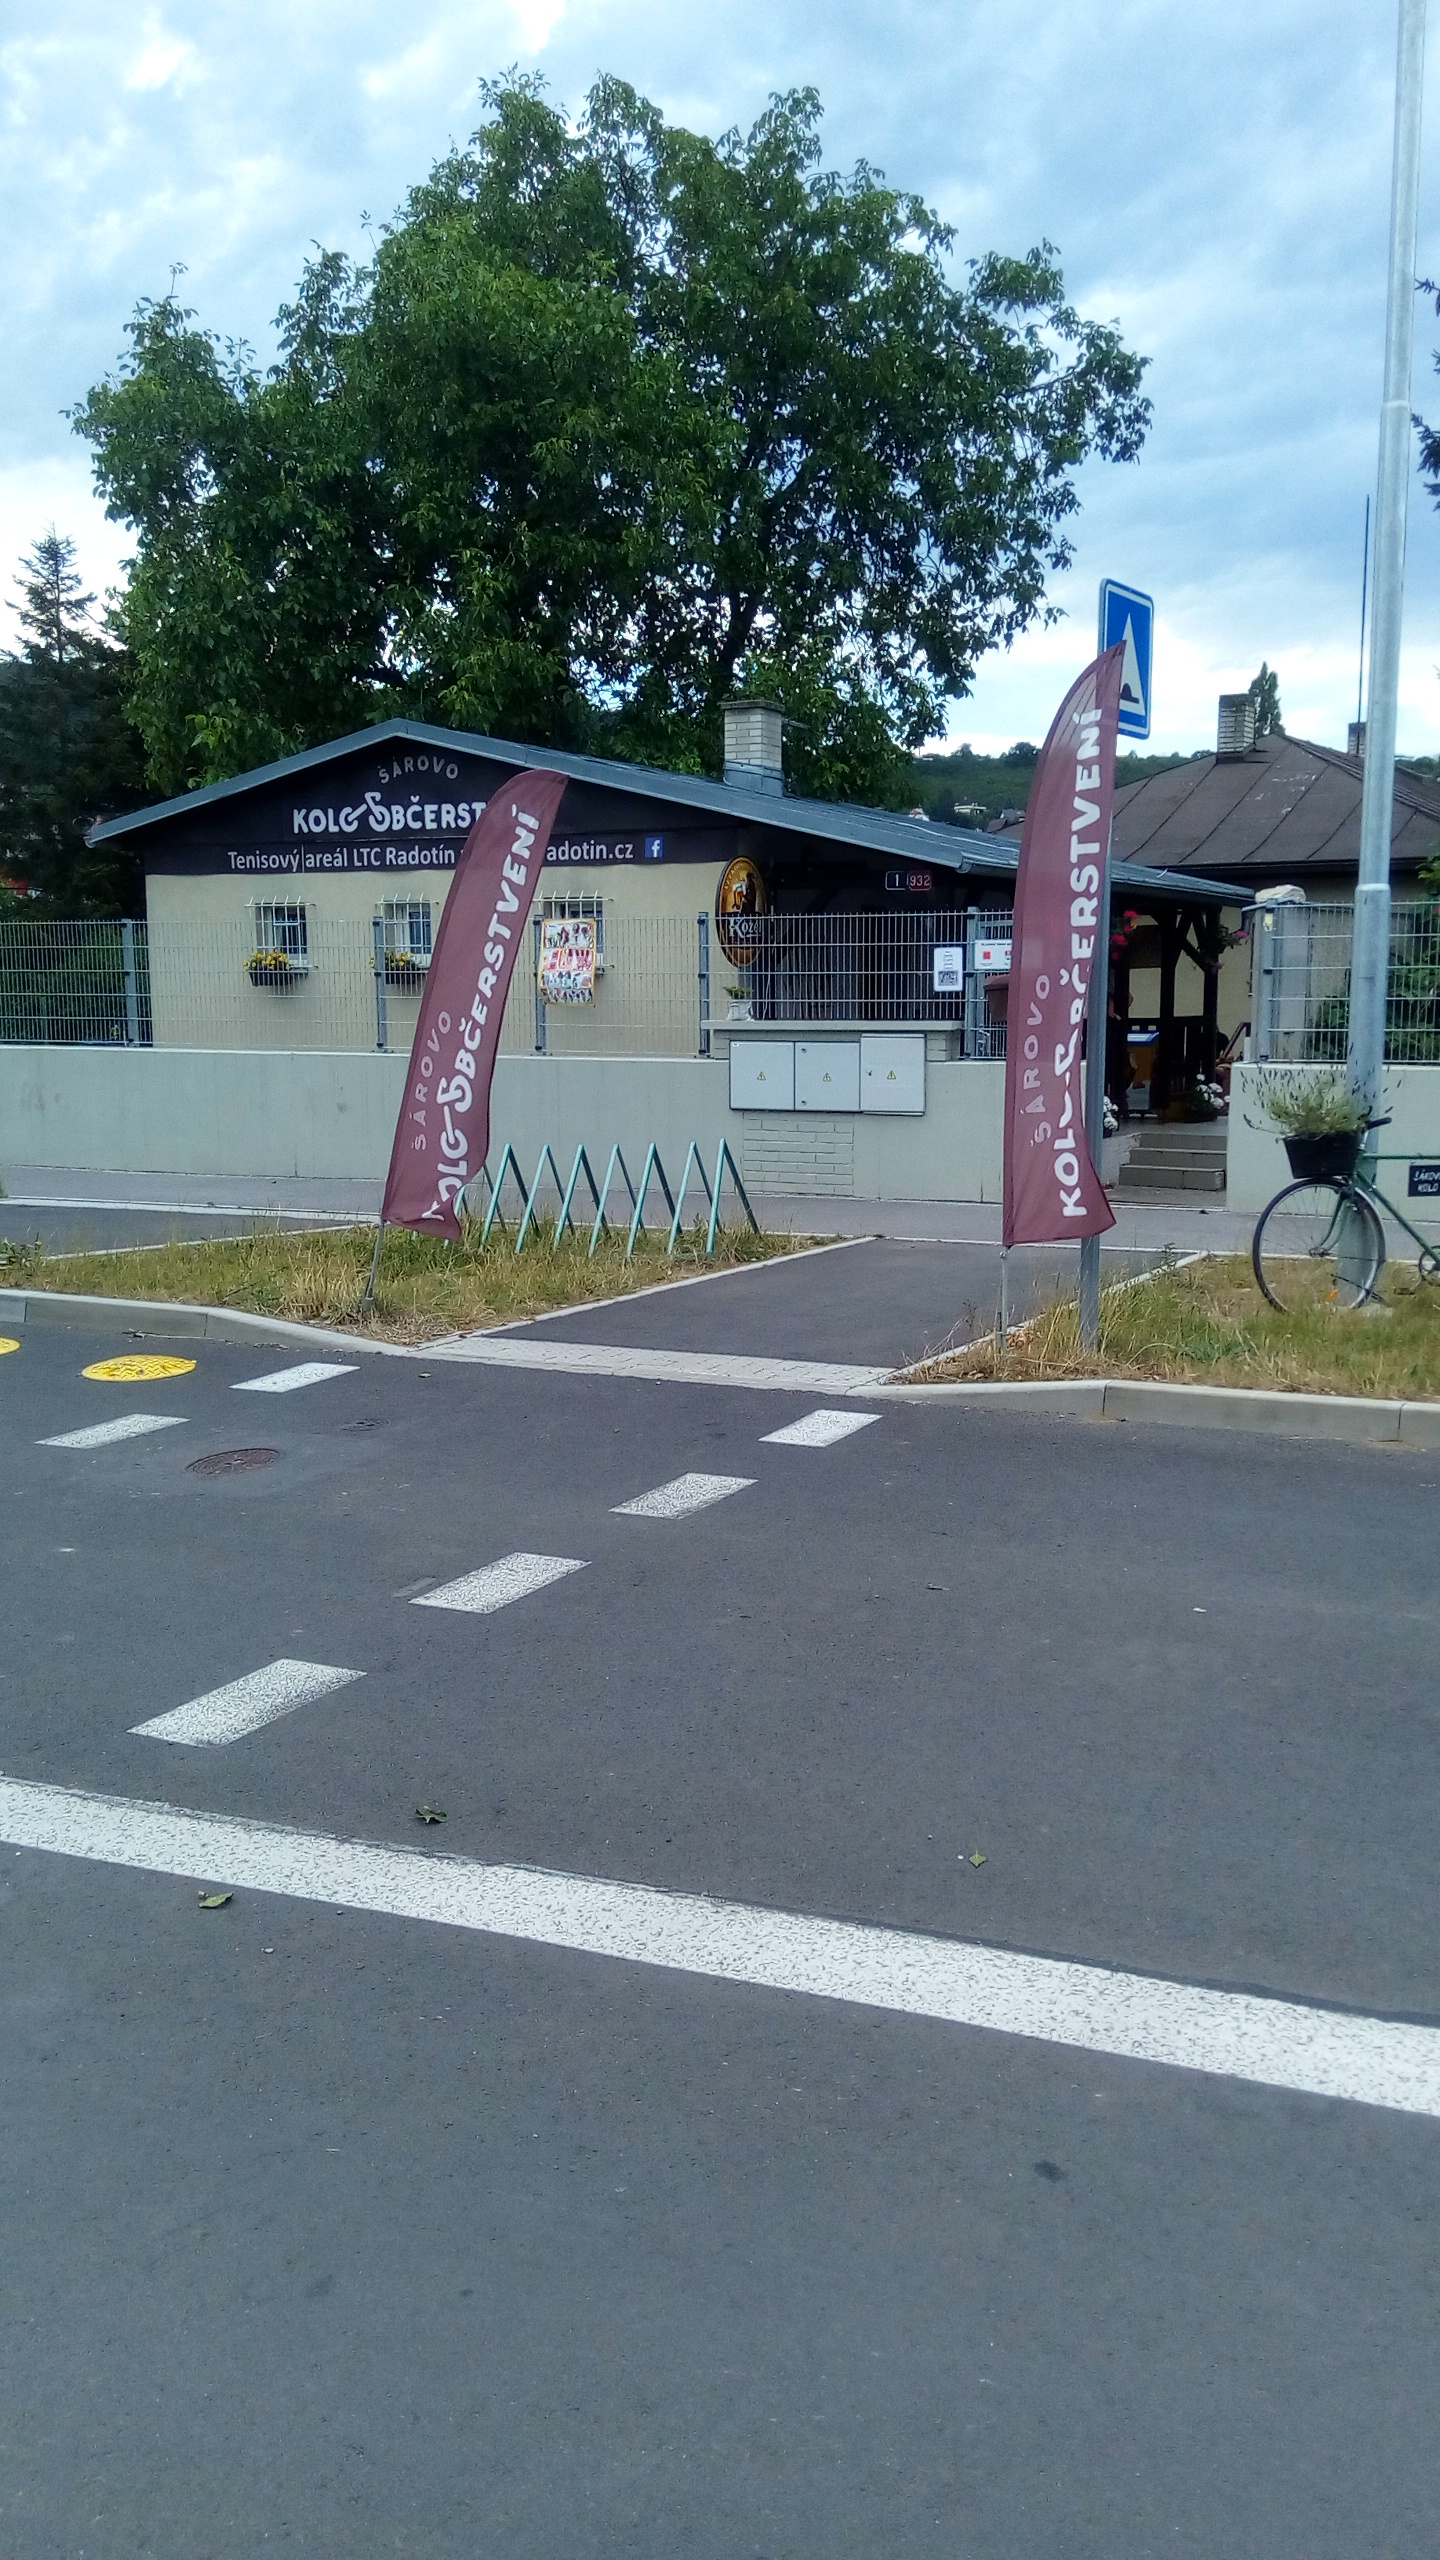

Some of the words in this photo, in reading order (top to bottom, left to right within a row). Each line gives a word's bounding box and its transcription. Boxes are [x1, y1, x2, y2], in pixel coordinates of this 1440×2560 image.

[377, 755, 459, 784] ŠÁROVO
[228, 849, 300, 872] Tenisový
[305, 847, 348, 868] areál
[353, 847, 381, 866] LTC
[386, 844, 455, 865] Radotín
[546, 839, 634, 861] adotin.cz
[895, 873, 899, 887] 1
[910, 875, 931, 887] 932
[1020, 974, 1052, 1147] ŠÁROVO
[410, 1011, 452, 1151] ŠÁROVO
